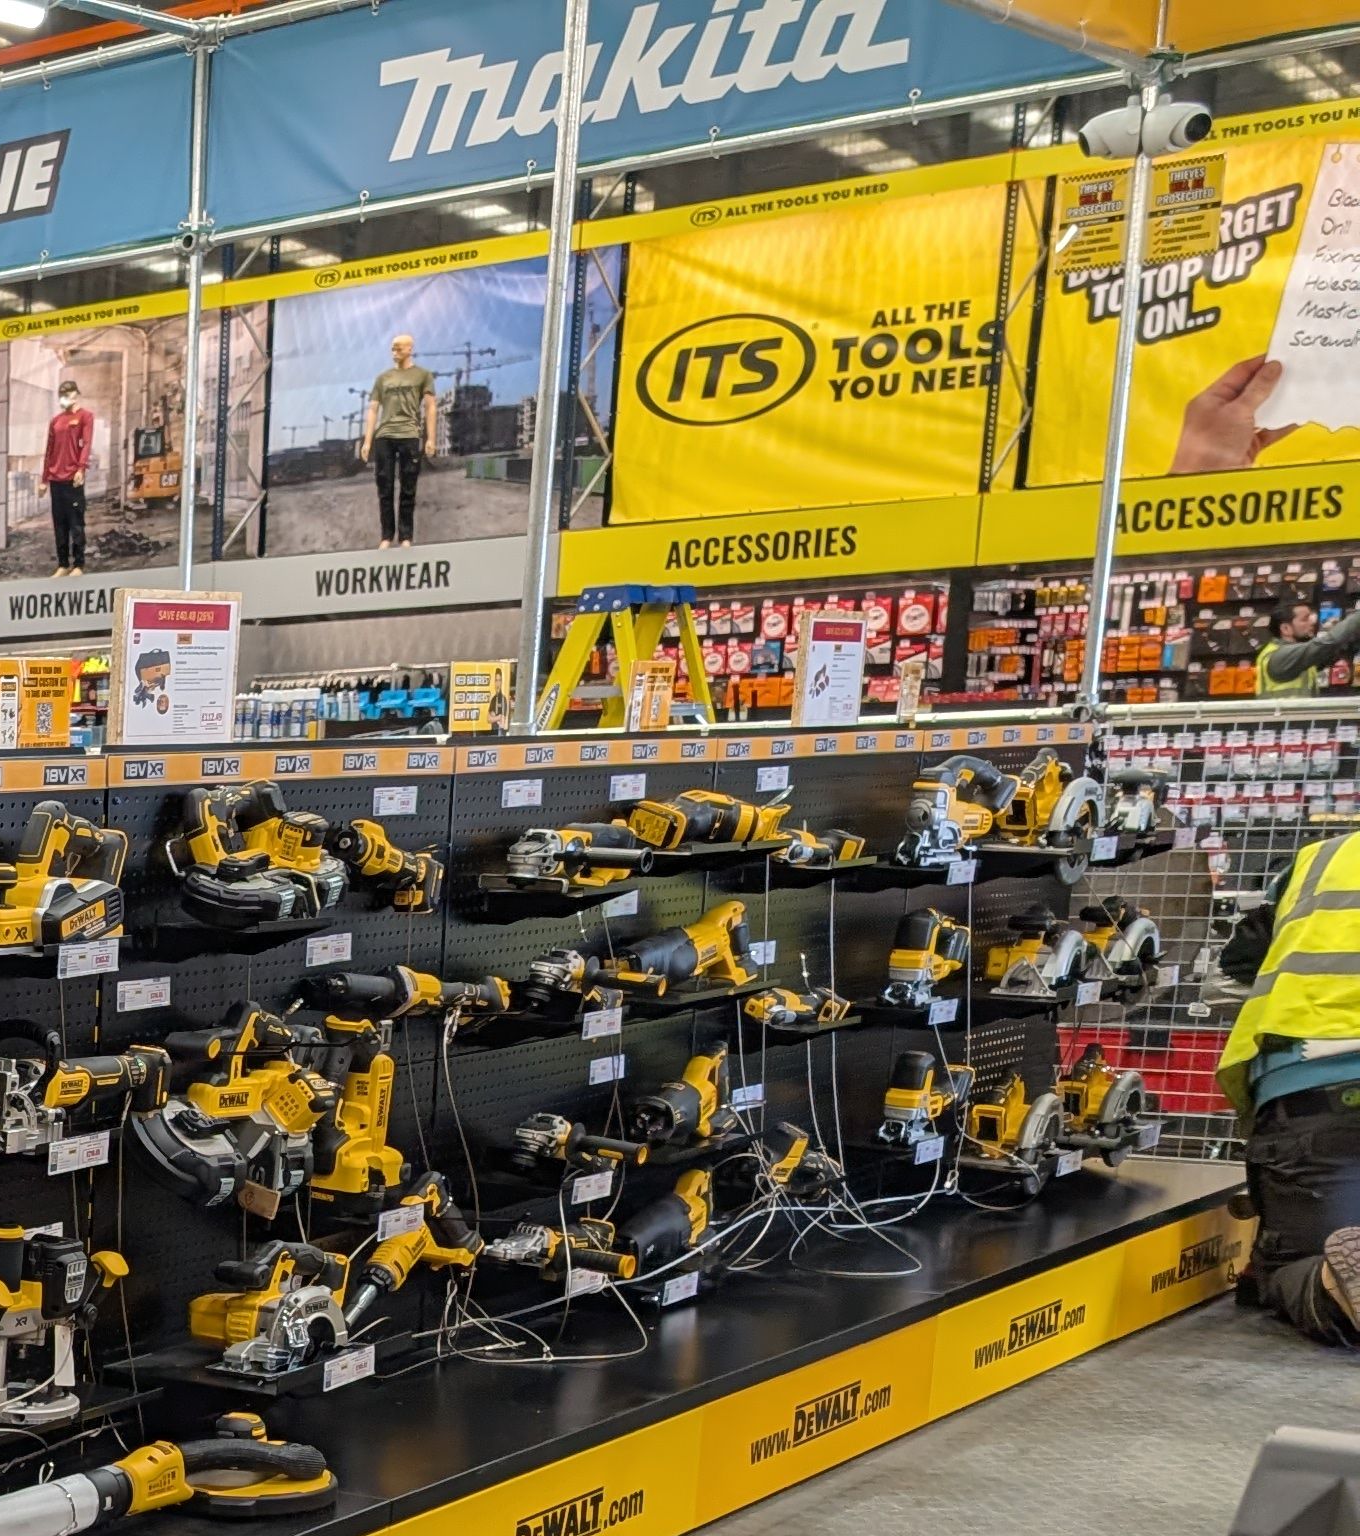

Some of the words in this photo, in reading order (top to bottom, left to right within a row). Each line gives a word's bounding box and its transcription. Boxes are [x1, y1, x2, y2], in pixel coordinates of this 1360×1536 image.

[1220, 121, 1250, 138] THE
[1252, 115, 1305, 136] TOOLS
[1308, 110, 1341, 129] YOU
[725, 204, 747, 219] ALL
[748, 201, 769, 217] THE
[772, 195, 815, 214] TOOLS
[818, 190, 846, 206] YOU
[848, 182, 890, 201] NEED
[344, 267, 363, 281] ALL
[365, 264, 384, 278] THE
[386, 259, 421, 275] TOOLS
[423, 254, 446, 269] YOU
[448, 250, 479, 266] NEED
[1140, 257, 1205, 303] TOP
[1211, 242, 1262, 284] UP
[27, 319, 43, 332] ALL
[46, 317, 62, 330] THE
[64, 313, 92, 328] TOOLS
[94, 310, 113, 323] YOU
[114, 305, 140, 320] NEED
[1142, 297, 1216, 341] ON...
[667, 343, 783, 403] ITS
[871, 307, 917, 328] ALL
[924, 299, 971, 322] THE
[831, 318, 998, 372] TOOLS
[829, 371, 897, 403] YOU
[664, 525, 858, 570] ACCESSORIES
[315, 560, 451, 598] WORKWEAR
